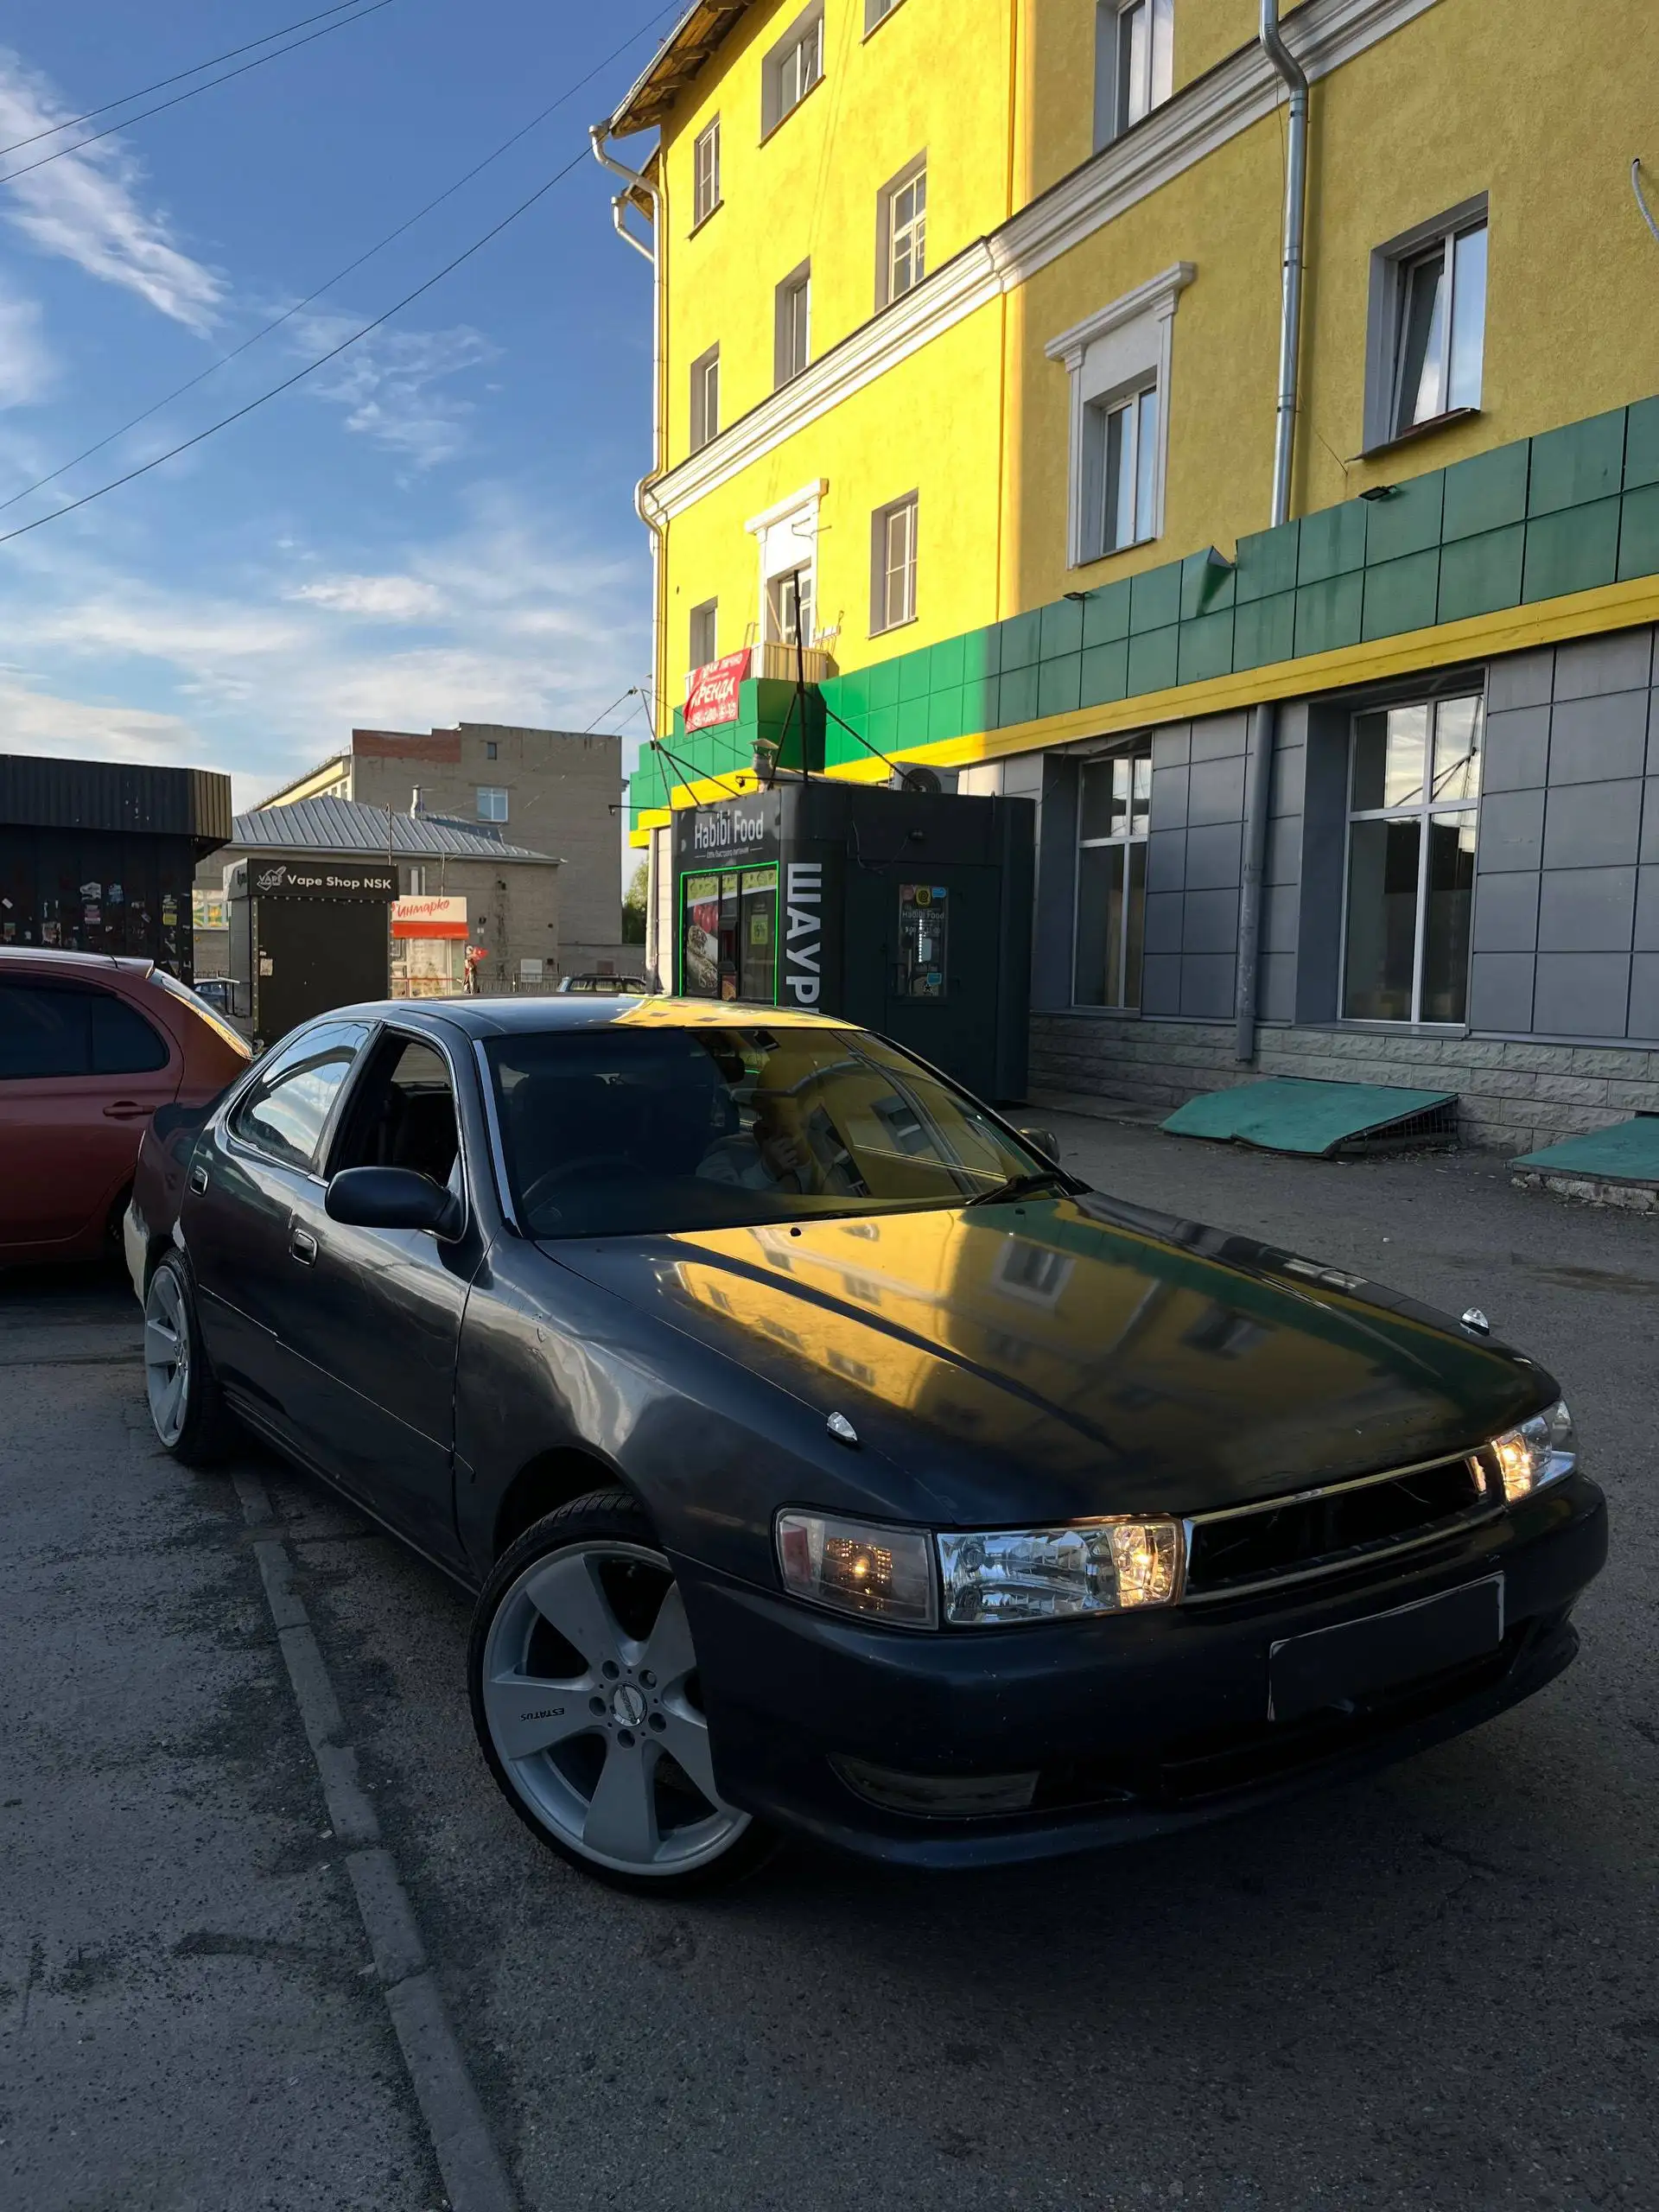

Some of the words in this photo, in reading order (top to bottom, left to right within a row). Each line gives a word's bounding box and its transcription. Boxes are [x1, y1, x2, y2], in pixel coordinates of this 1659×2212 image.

[694, 810, 730, 849] Habibi
[734, 810, 764, 843] Food
[287, 874, 322, 887] Vape
[326, 876, 360, 889] Shop
[364, 878, 391, 889] NSK
[397, 899, 450, 918] Инмарко
[785, 862, 822, 1014] ШАУР
[520, 1707, 565, 1721] ESTATUS
